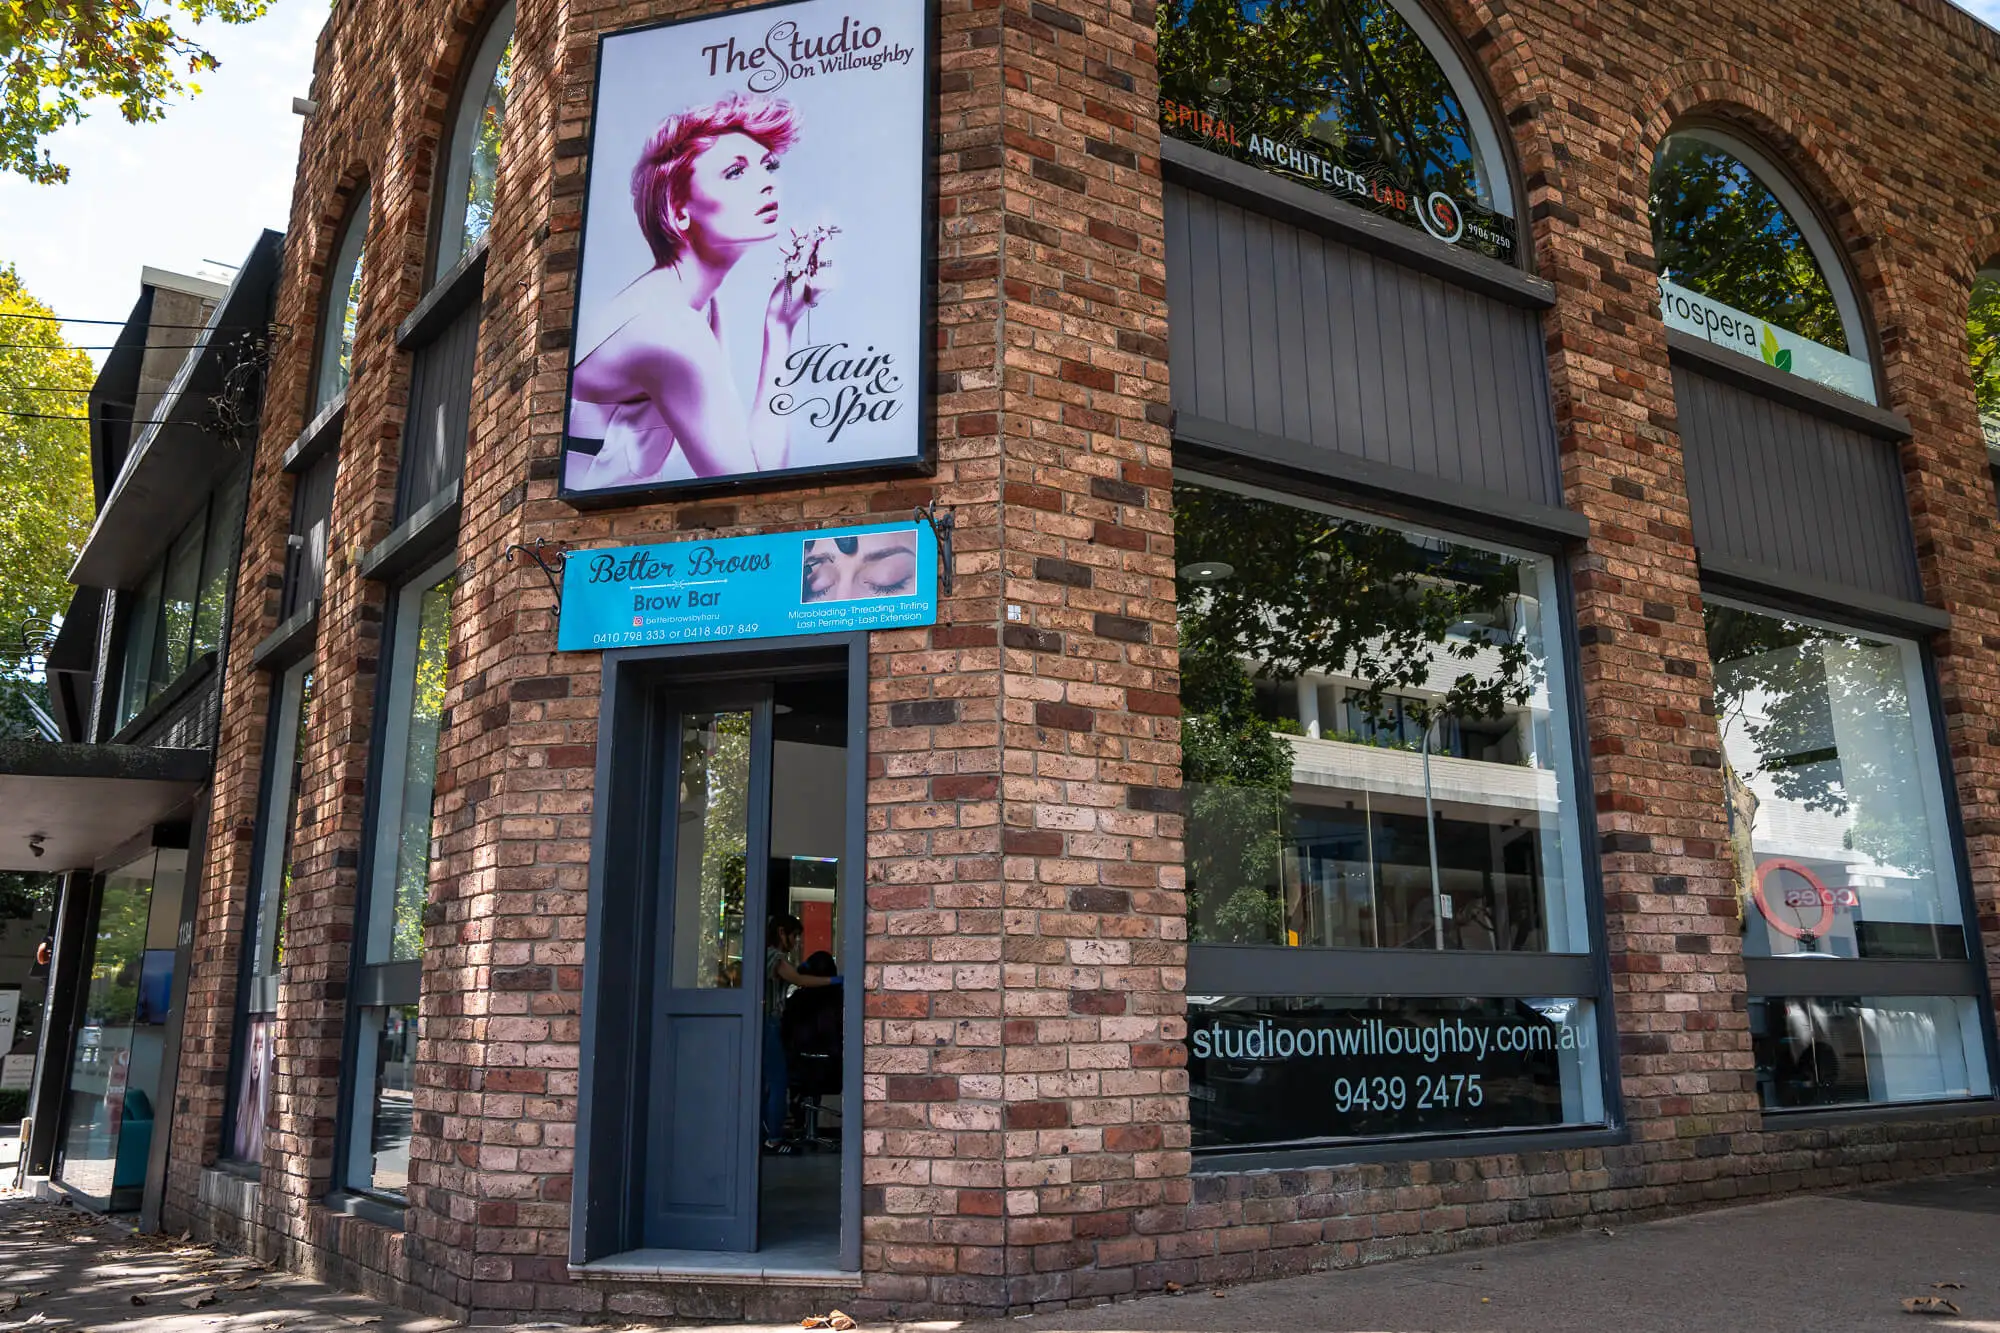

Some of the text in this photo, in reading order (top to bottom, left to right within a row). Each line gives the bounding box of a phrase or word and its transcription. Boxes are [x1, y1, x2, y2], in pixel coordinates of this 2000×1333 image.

[701, 16, 882, 93] The Studio
[789, 43, 914, 80] On Willoughby
[1163, 99, 1407, 212] SPIRAL ARCHITECTS LAB
[774, 342, 904, 396] Hair &
[769, 385, 904, 443] Spa
[588, 546, 773, 584] Better Brows
[633, 590, 722, 612] Brow Bar
[788, 601, 929, 619] Microblading Threading Tinting
[593, 623, 759, 644] 0410 798 333 or 0418 407 849
[796, 612, 922, 629] Lash Perming Lash Extension
[1192, 1018, 1591, 1063] studioonwilloughby.com.au
[1334, 1074, 1483, 1113] 9439 2475
